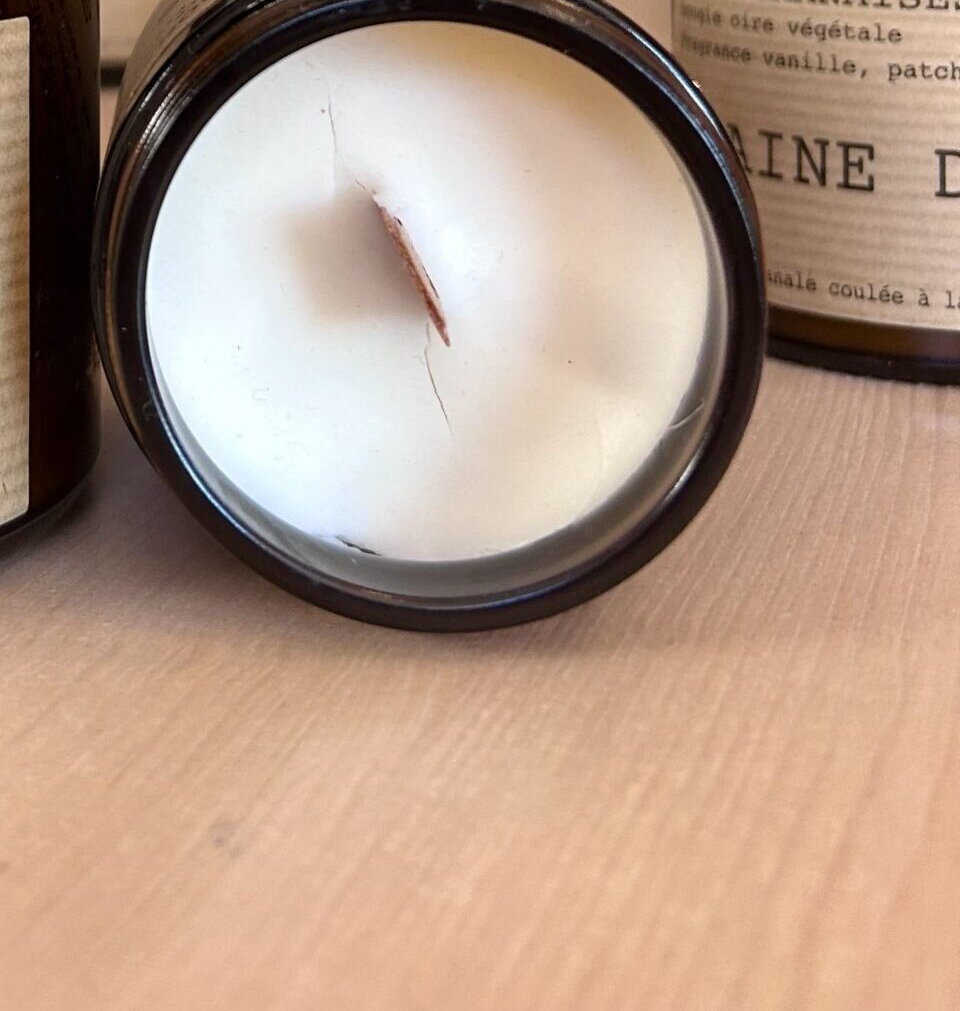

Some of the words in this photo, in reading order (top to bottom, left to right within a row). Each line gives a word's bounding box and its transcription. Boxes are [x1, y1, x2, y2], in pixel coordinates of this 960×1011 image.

[729, 10, 774, 33] cire
[787, 19, 902, 44] végétale
[828, 282, 904, 305] coulée
[918, 288, 930, 308] à
